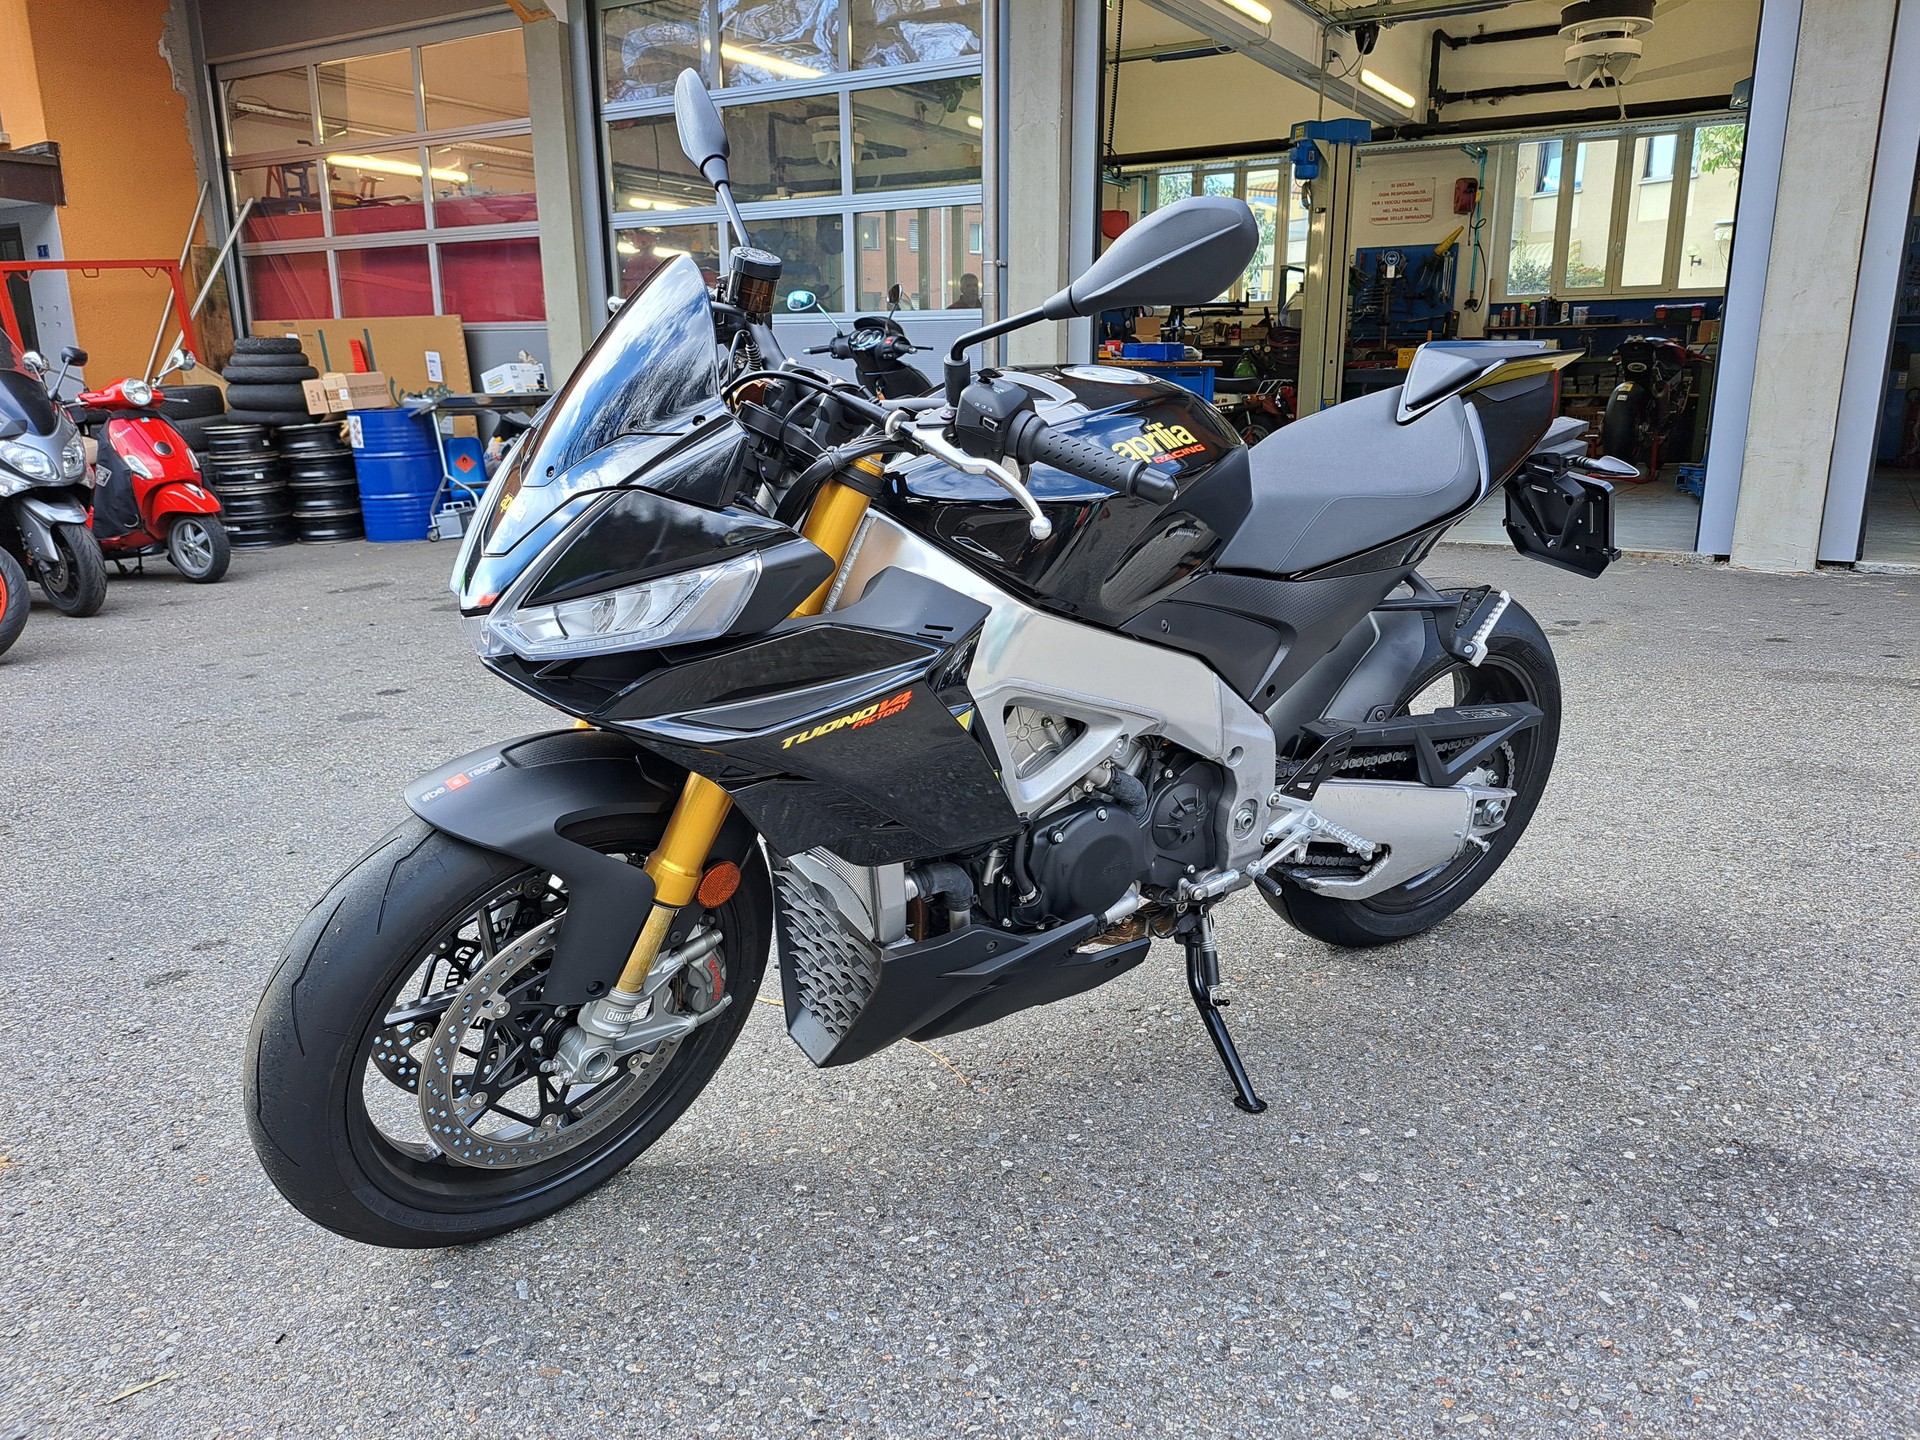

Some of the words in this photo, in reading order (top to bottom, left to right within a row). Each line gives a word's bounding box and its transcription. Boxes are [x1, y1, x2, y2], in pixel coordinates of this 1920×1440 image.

[1111, 421, 1198, 464] aprilia
[1152, 443, 1206, 465] RACING
[781, 703, 880, 750] TUONO
[851, 701, 910, 730] FACTORY
[420, 786, 446, 802] #be
